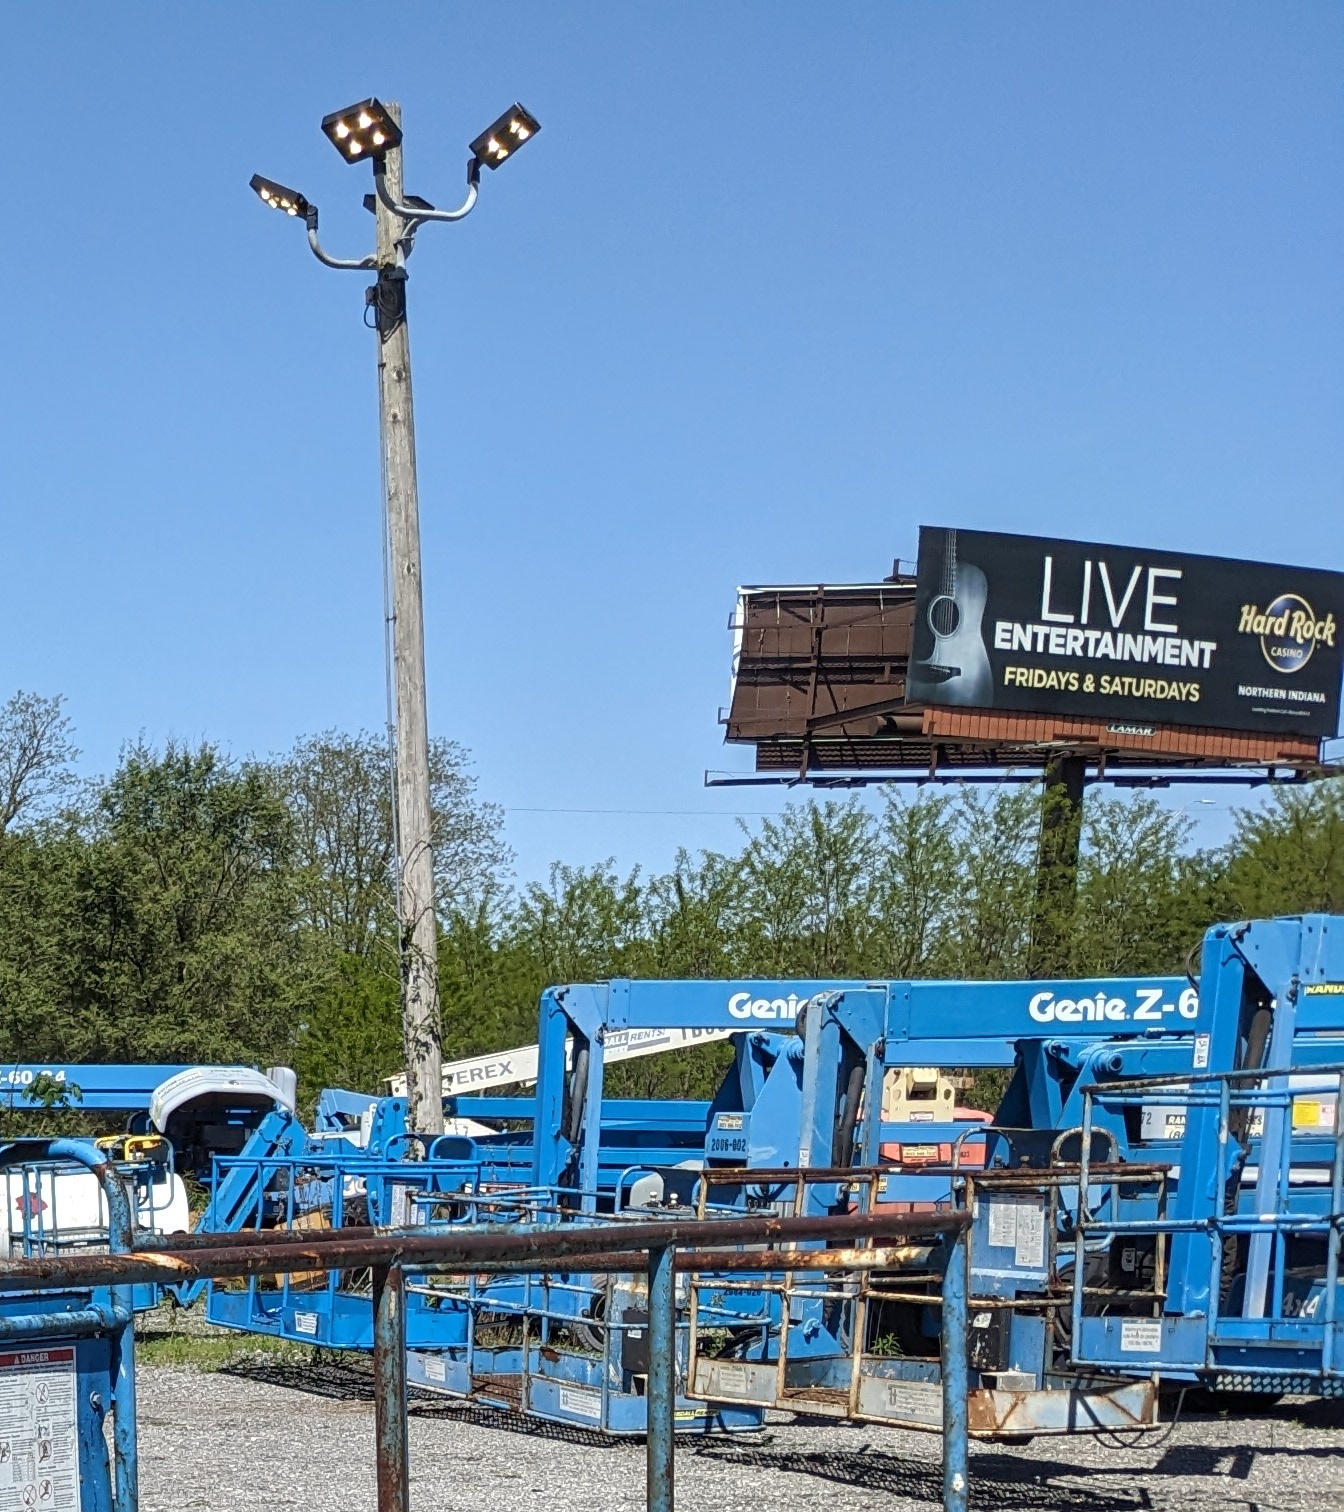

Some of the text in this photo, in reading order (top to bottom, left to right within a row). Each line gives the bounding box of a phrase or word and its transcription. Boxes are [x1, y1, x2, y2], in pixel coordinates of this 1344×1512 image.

[1041, 556, 1182, 634] LIVE
[1238, 604, 1336, 647] Hard Rock
[994, 621, 1217, 669] ENTERTAINMENT
[1271, 647, 1303, 659] CASINO
[1004, 666, 1200, 702] FRIDAYS & SATURDAYS
[1238, 685, 1326, 703] NORTHERN INDIANA
[1029, 992, 1126, 1022] Genie
[21, 1353, 49, 1363] DANGER
